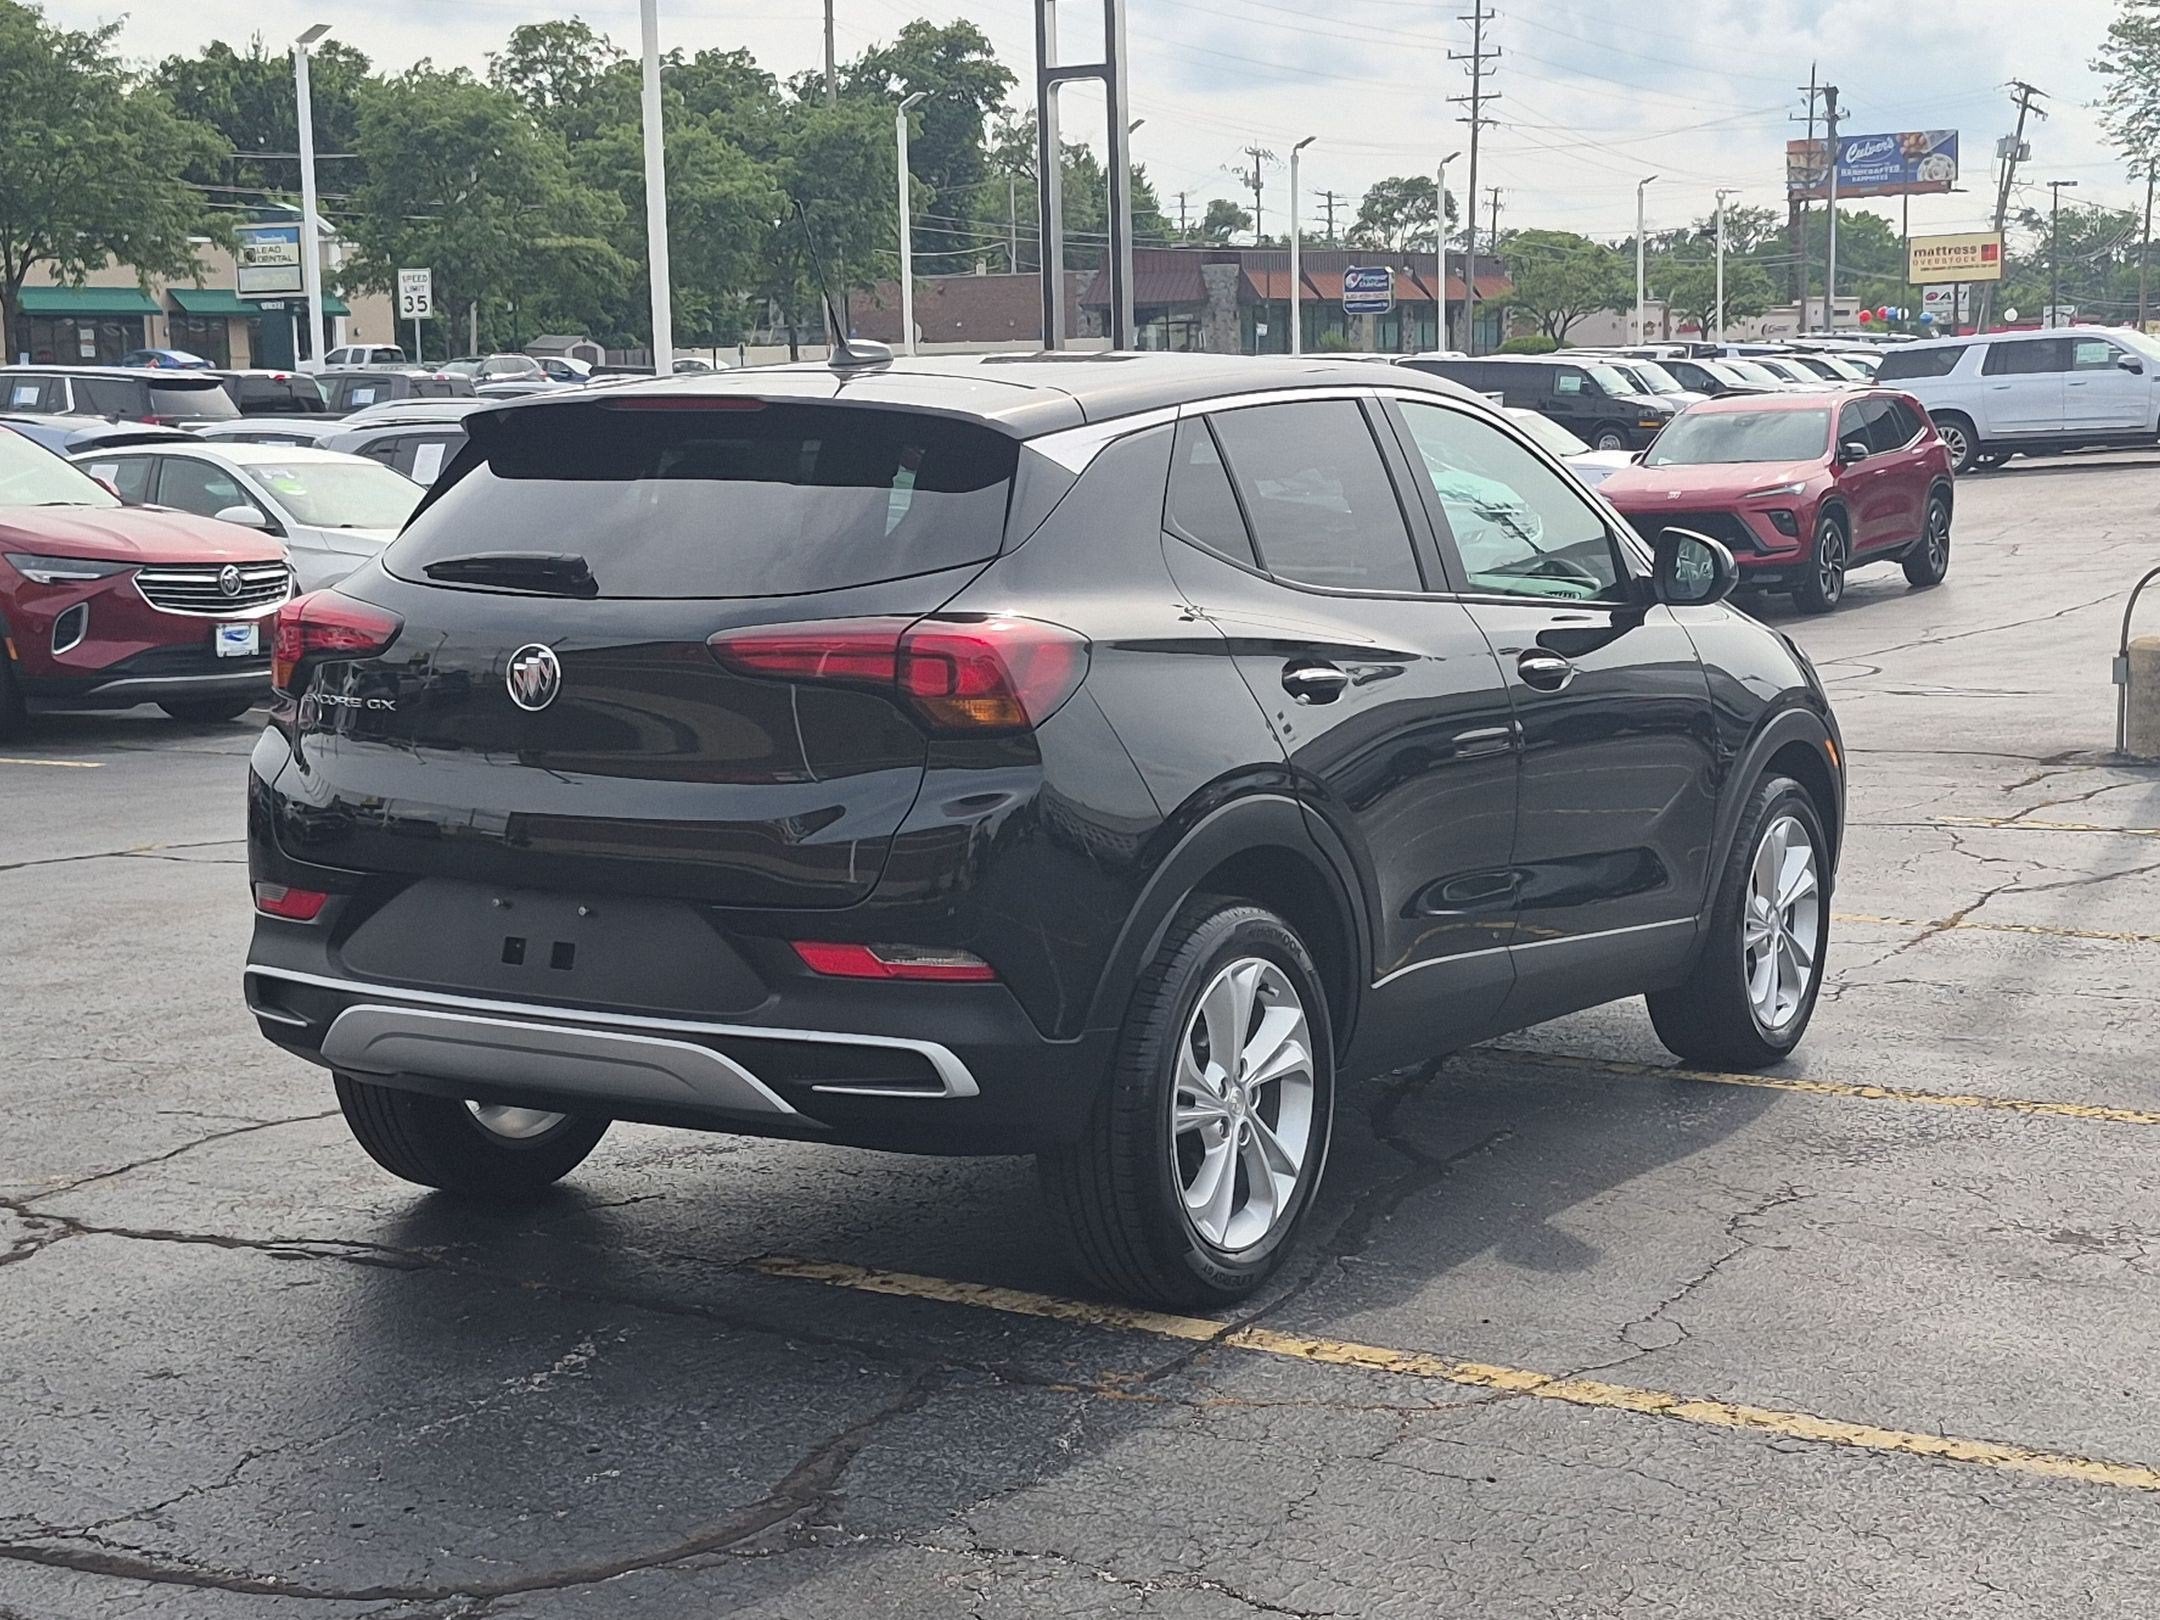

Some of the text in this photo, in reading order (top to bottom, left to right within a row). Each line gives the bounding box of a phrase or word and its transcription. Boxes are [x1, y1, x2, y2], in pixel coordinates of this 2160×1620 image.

[1845, 136, 1894, 163] Culver's
[256, 245, 282, 255] LEAD
[1914, 246, 1977, 257] mattress
[257, 254, 292, 263] DENTAL
[1912, 256, 1976, 266] OVERSTOCK
[402, 274, 428, 283] SPEED
[404, 285, 425, 293] LIMIT
[403, 295, 428, 313] 35
[366, 698, 396, 711] GX
